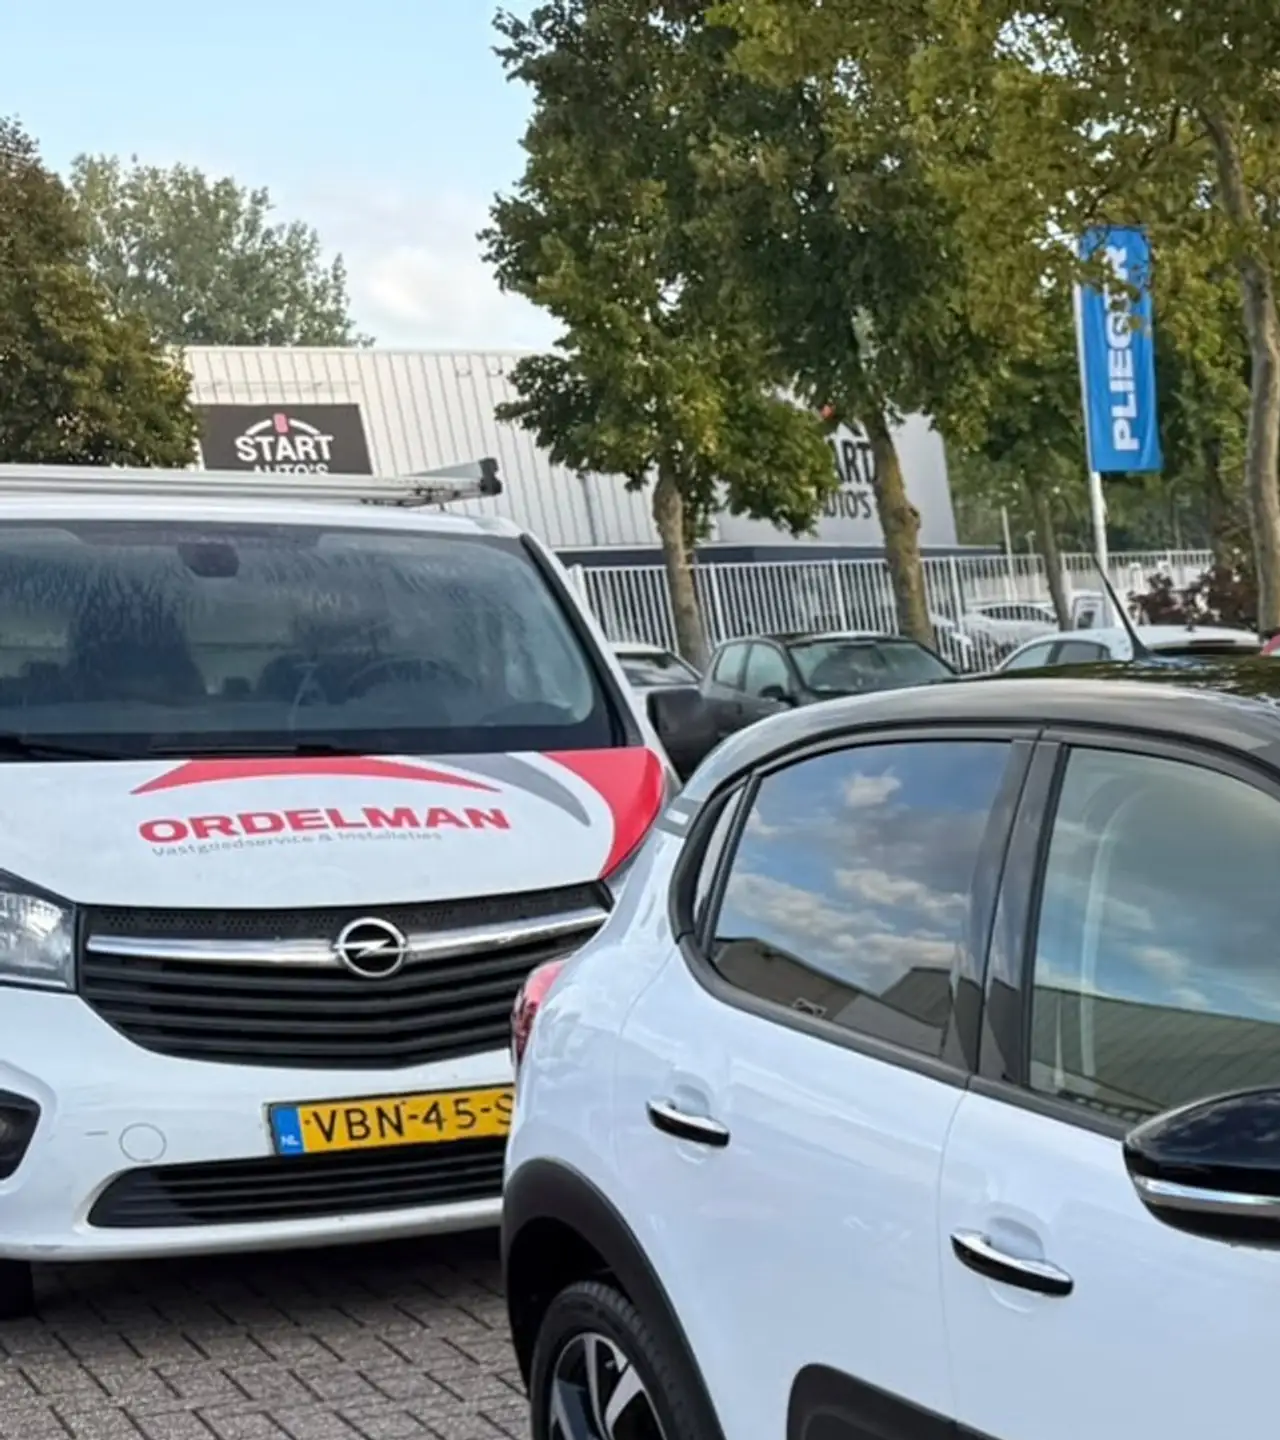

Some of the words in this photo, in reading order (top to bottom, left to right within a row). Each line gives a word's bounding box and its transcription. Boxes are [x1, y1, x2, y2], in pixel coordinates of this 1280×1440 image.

[234, 435, 334, 461] START
[139, 807, 510, 843] ORDELMAN
[312, 1094, 513, 1143] VBN-45-S
